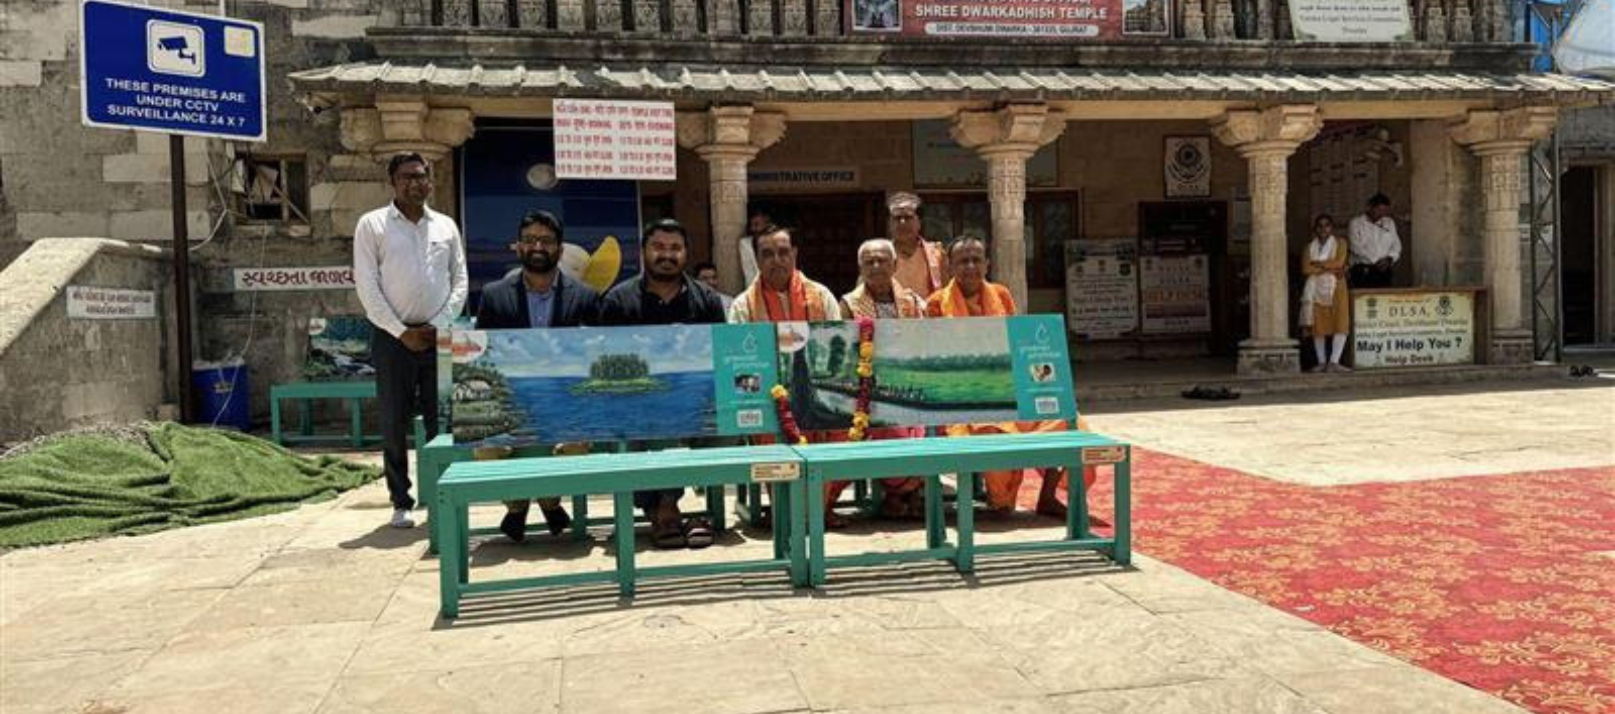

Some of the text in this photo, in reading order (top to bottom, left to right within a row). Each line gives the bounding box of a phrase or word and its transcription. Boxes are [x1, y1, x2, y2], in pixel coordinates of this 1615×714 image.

[916, 5, 1107, 19] SHREE DWARKADHISH TEMPLE
[105, 77, 246, 103] THESE PREMISES ARE
[137, 94, 219, 112] UNDER CCTV
[107, 104, 245, 127] SURVEILLANCE 24 X 7
[1356, 340, 1383, 353] May
[1386, 339, 1392, 351] I
[1395, 338, 1424, 352] Help
[1428, 337, 1451, 350] You
